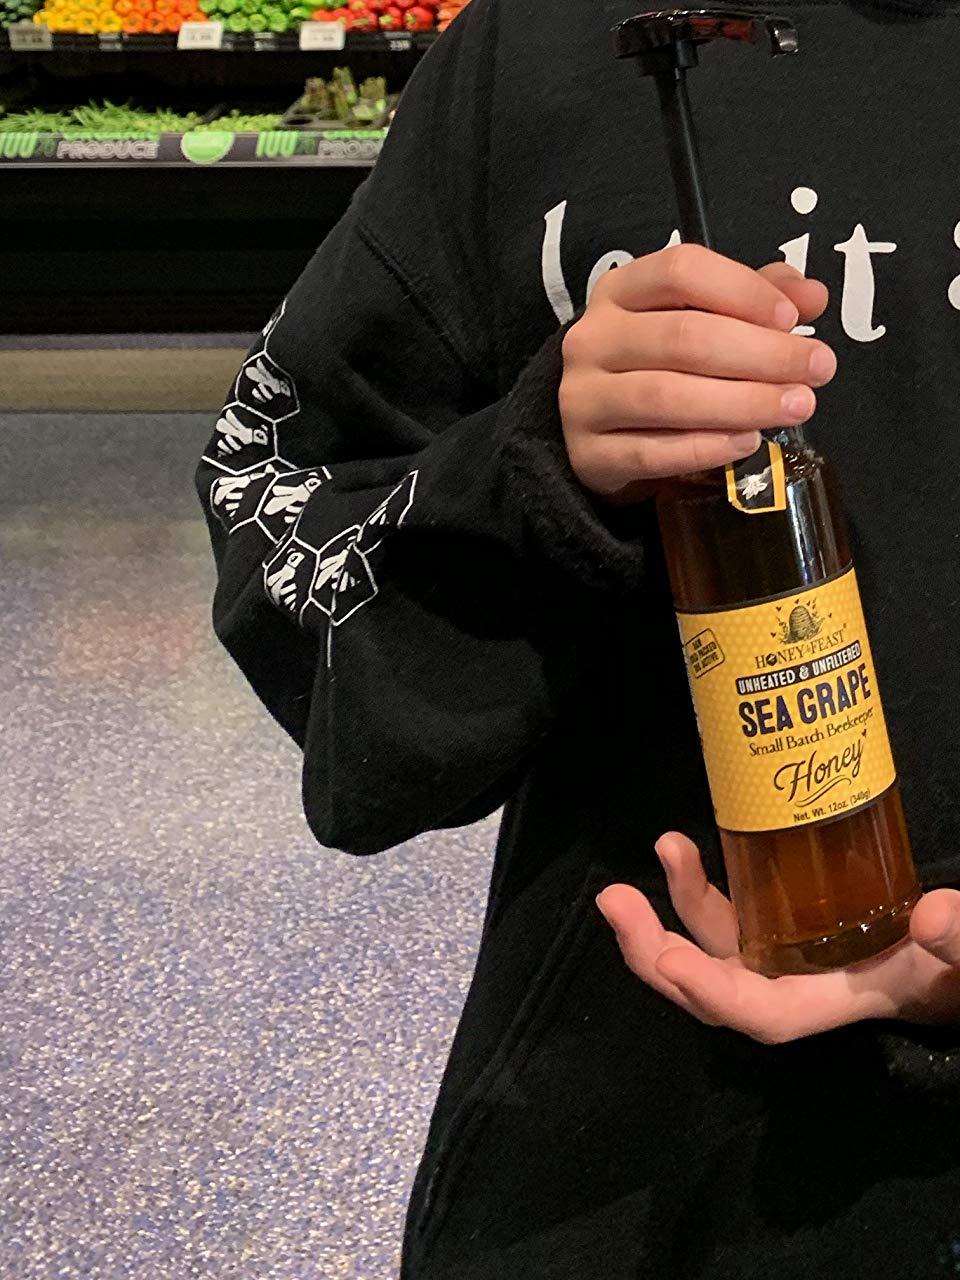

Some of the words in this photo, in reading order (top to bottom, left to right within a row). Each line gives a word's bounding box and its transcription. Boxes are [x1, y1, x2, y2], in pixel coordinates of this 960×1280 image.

[57, 140, 160, 160] PRODUCE
[318, 140, 380, 160] PROD
[738, 669, 796, 694] UNHEATED
[799, 665, 810, 680] &
[812, 642, 861, 676] UNFILTERED
[738, 695, 794, 737] SEA
[796, 662, 871, 724] GRAPE
[749, 737, 784, 757] Small
[786, 729, 825, 750] Batch
[773, 739, 863, 802] Honey
[828, 801, 849, 813] 12oz.
